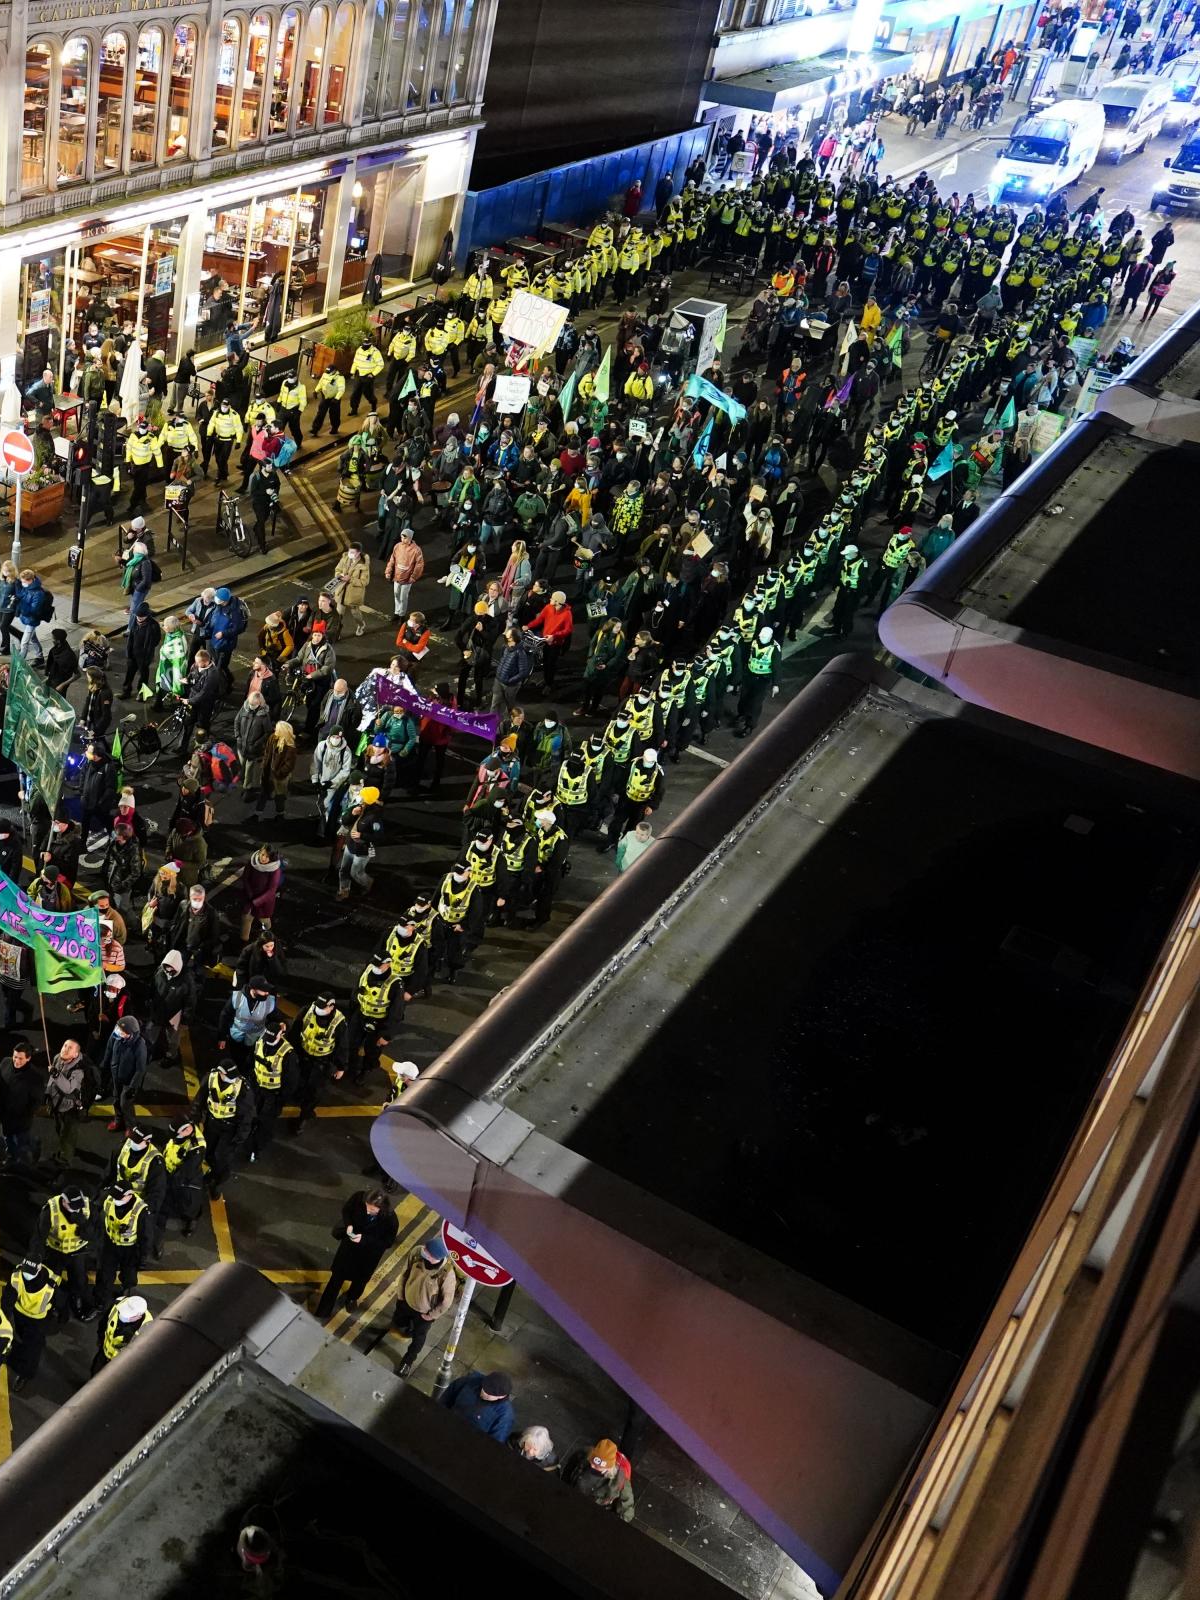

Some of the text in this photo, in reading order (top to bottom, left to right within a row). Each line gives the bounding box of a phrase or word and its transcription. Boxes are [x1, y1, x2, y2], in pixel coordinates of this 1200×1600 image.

[40, 3, 122, 22] CABINET
[76, 914, 97, 943] TO
[25, 1260, 37, 1268] POLICE
